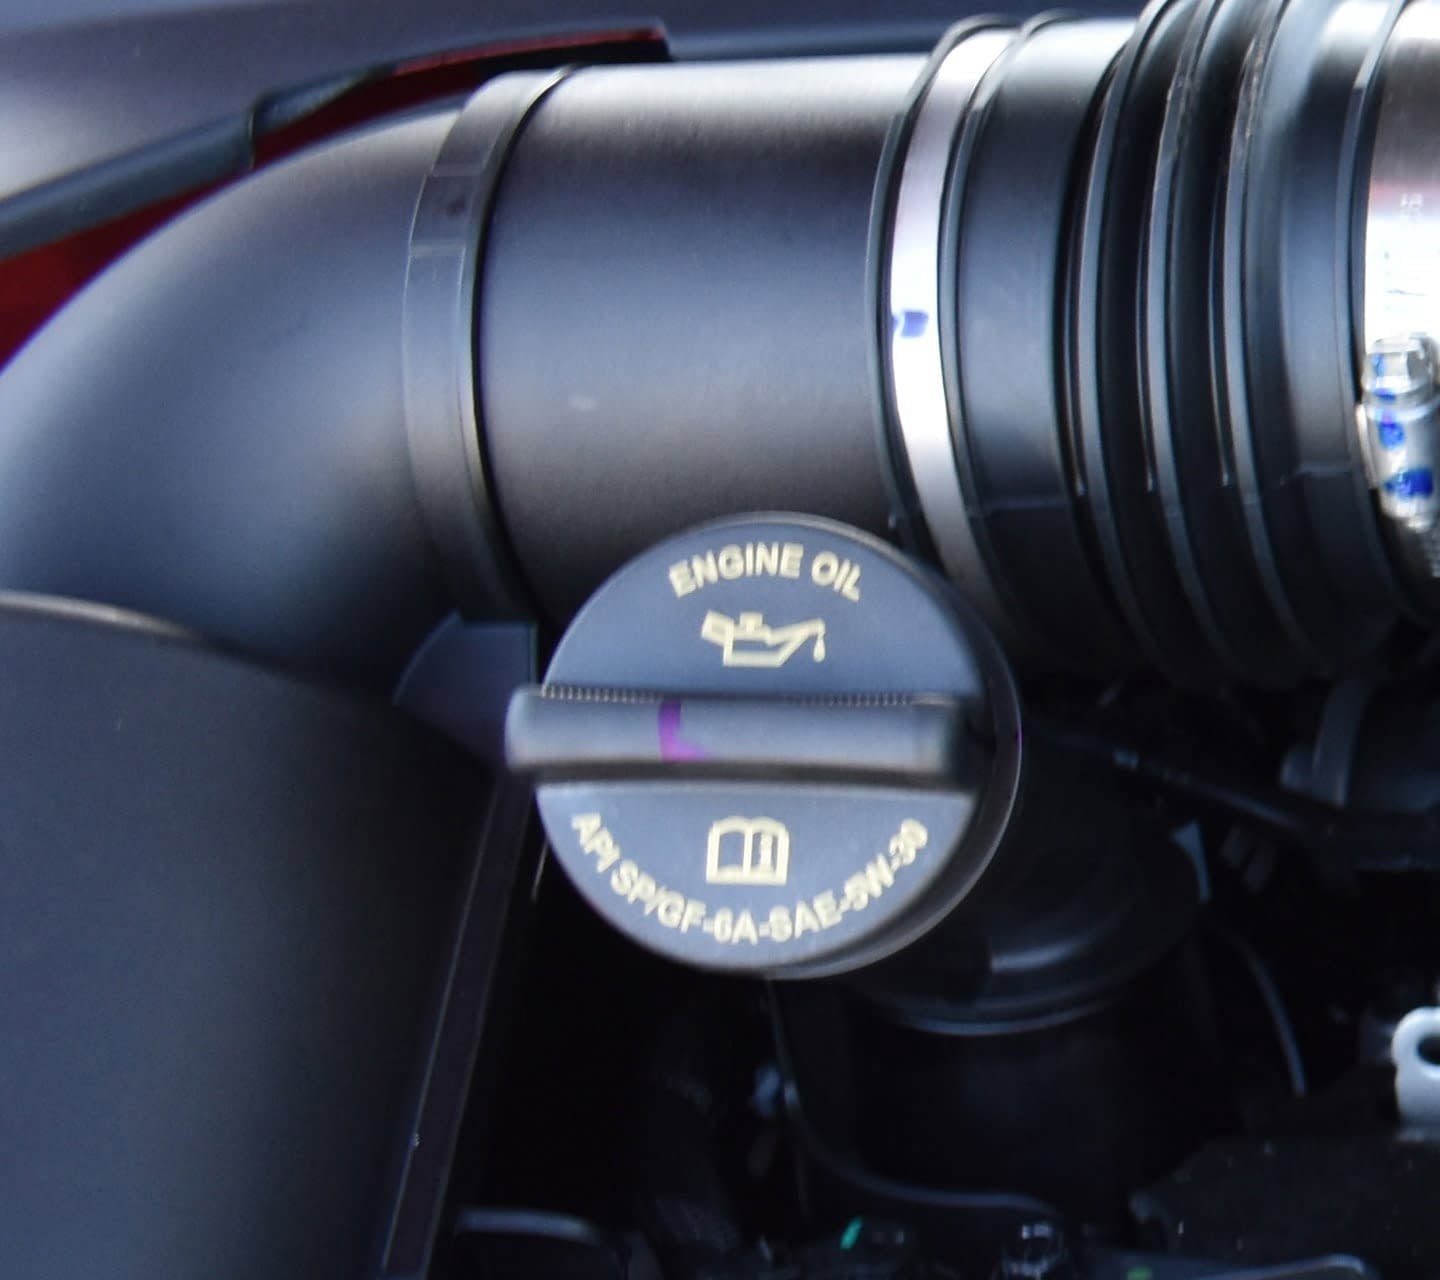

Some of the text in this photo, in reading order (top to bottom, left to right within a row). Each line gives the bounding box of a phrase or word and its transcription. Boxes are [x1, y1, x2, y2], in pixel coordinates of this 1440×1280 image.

[668, 541, 863, 602] ENGINE OIL
[570, 812, 622, 874] API
